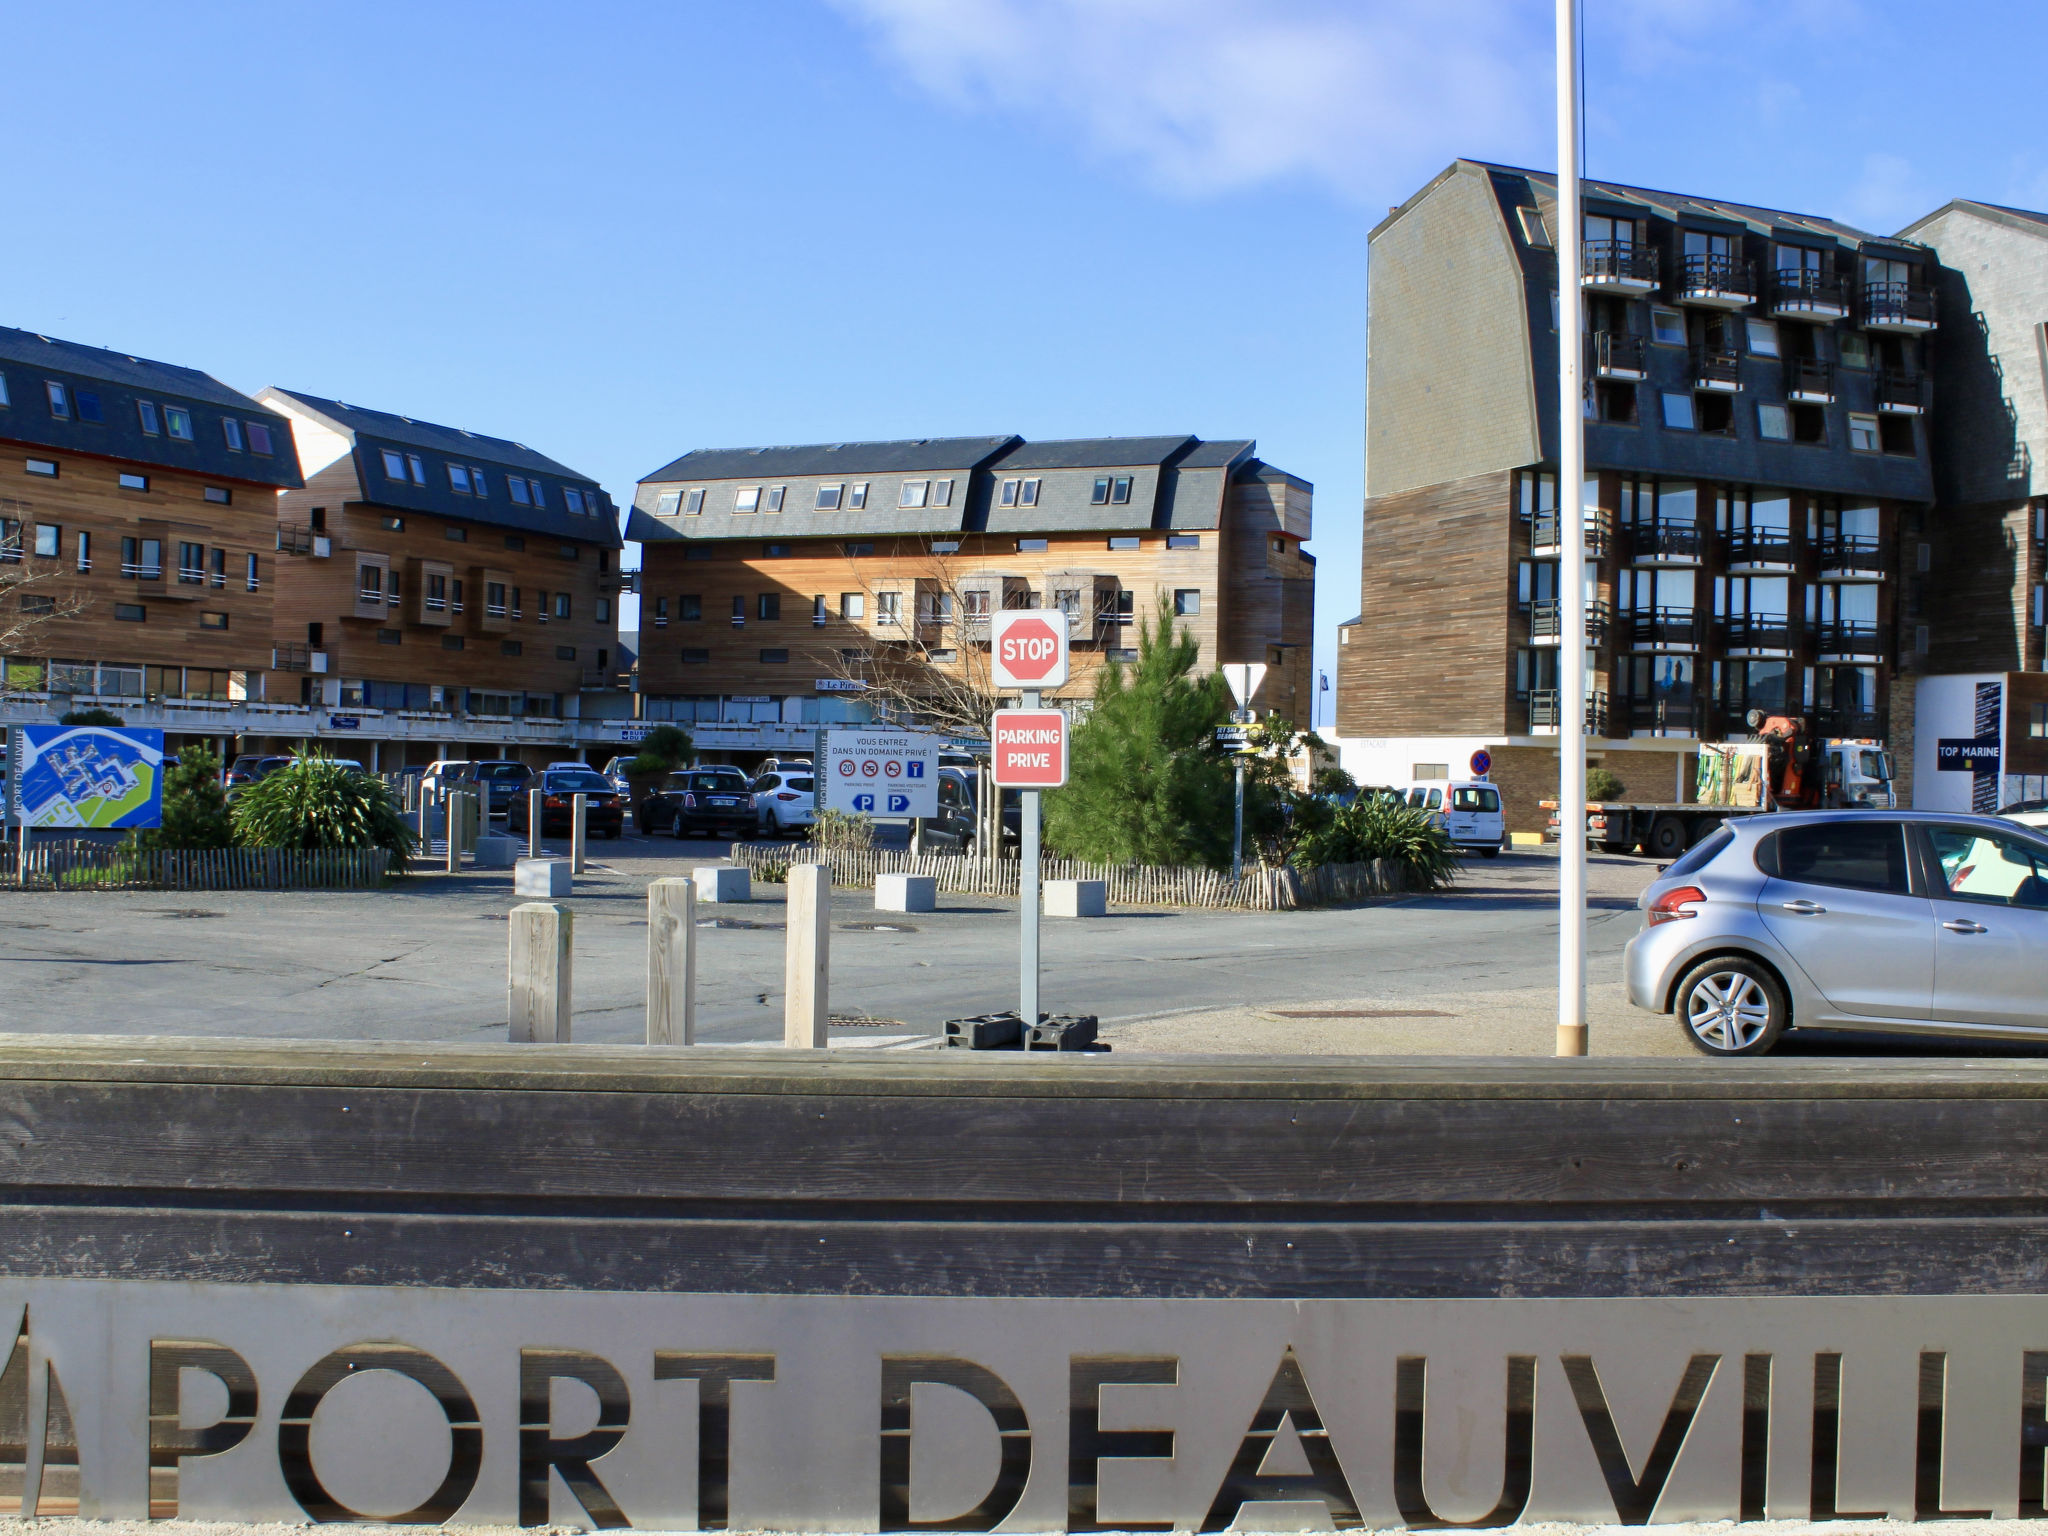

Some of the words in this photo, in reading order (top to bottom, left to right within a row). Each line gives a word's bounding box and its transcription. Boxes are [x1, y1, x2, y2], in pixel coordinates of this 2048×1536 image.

[1003, 638, 1055, 661] STOP
[827, 681, 837, 689] Le
[856, 738, 877, 746] VOUS
[879, 738, 908, 747] ENTREZ
[998, 729, 1060, 744] PARKING
[14, 728, 24, 783] DEAUVILLE
[832, 747, 853, 755] DANS
[855, 747, 866, 755] UN
[868, 747, 903, 756] DOMAINE
[905, 747, 927, 757] PRIVÉ
[1939, 746, 1959, 757] TOP
[1962, 746, 1999, 757] MARINE
[843, 763, 852, 772] 20
[1007, 753, 1050, 768] PRIVE
[13, 787, 23, 809] PORT
[861, 796, 872, 810] P
[891, 796, 902, 811] P
[149, 1336, 775, 1531] PORT
[879, 1342, 2048, 1533] DEAUVILL
